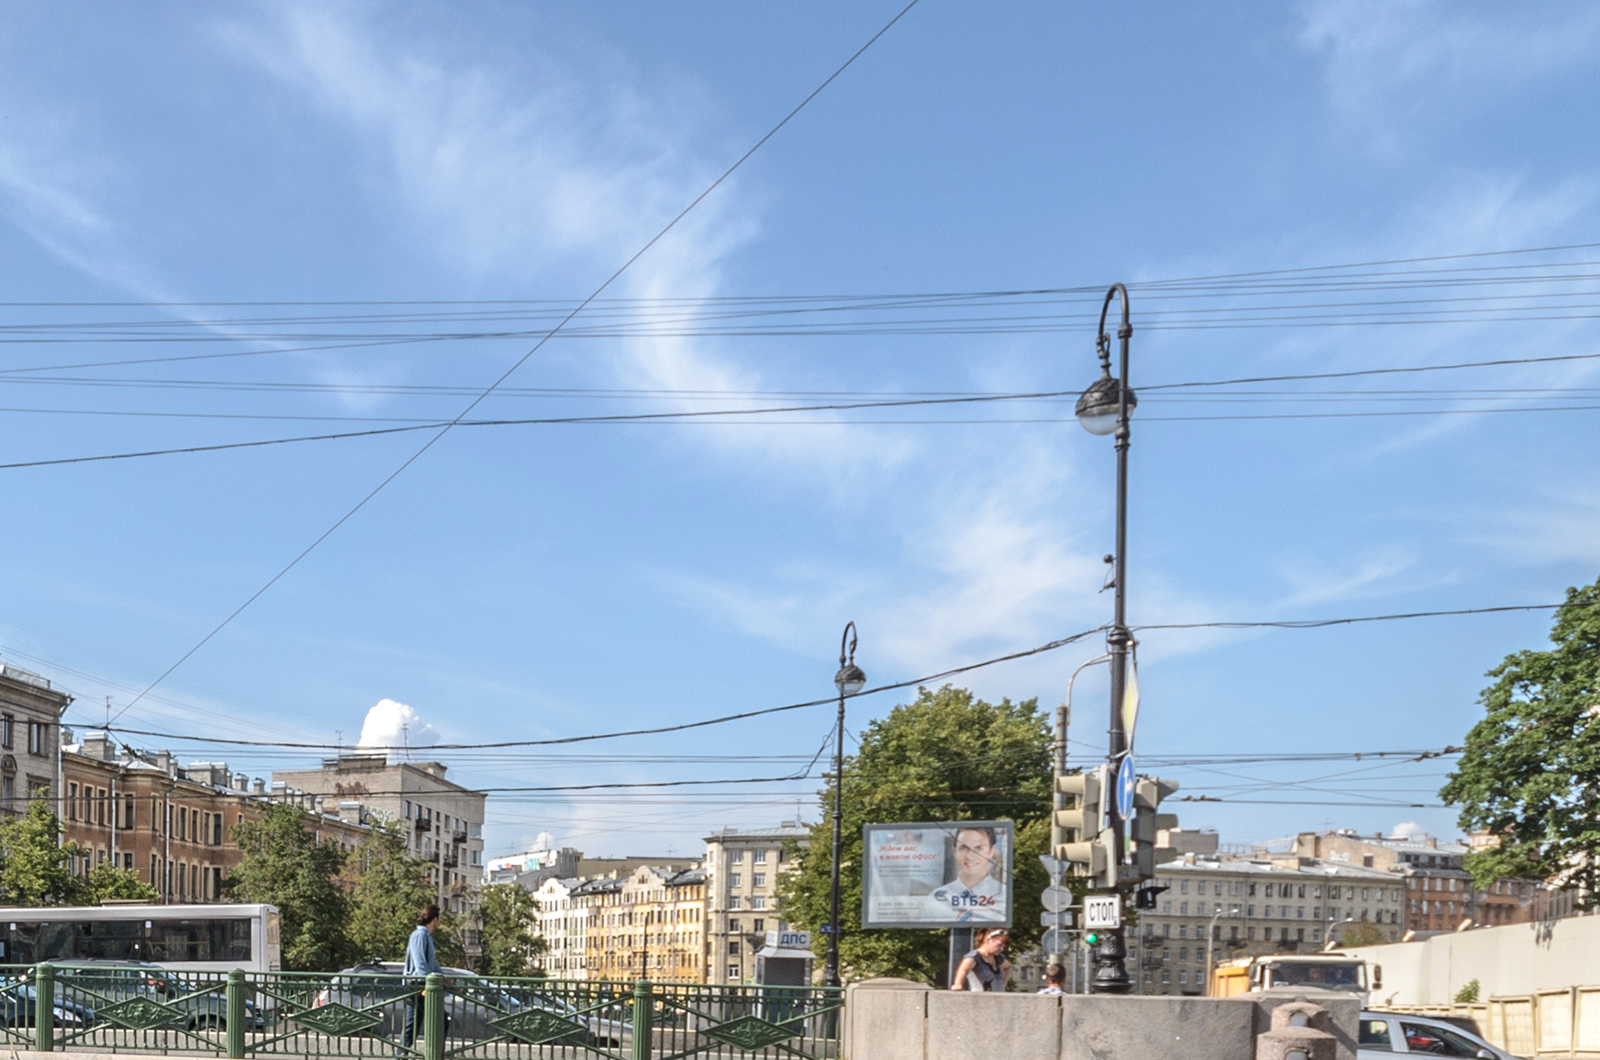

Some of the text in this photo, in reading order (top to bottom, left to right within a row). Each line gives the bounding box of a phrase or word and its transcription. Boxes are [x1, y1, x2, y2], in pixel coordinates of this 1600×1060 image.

[951, 895, 996, 907] ВТБ24
[1089, 902, 1114, 922] СТОП
[780, 934, 807, 945] ДПС
